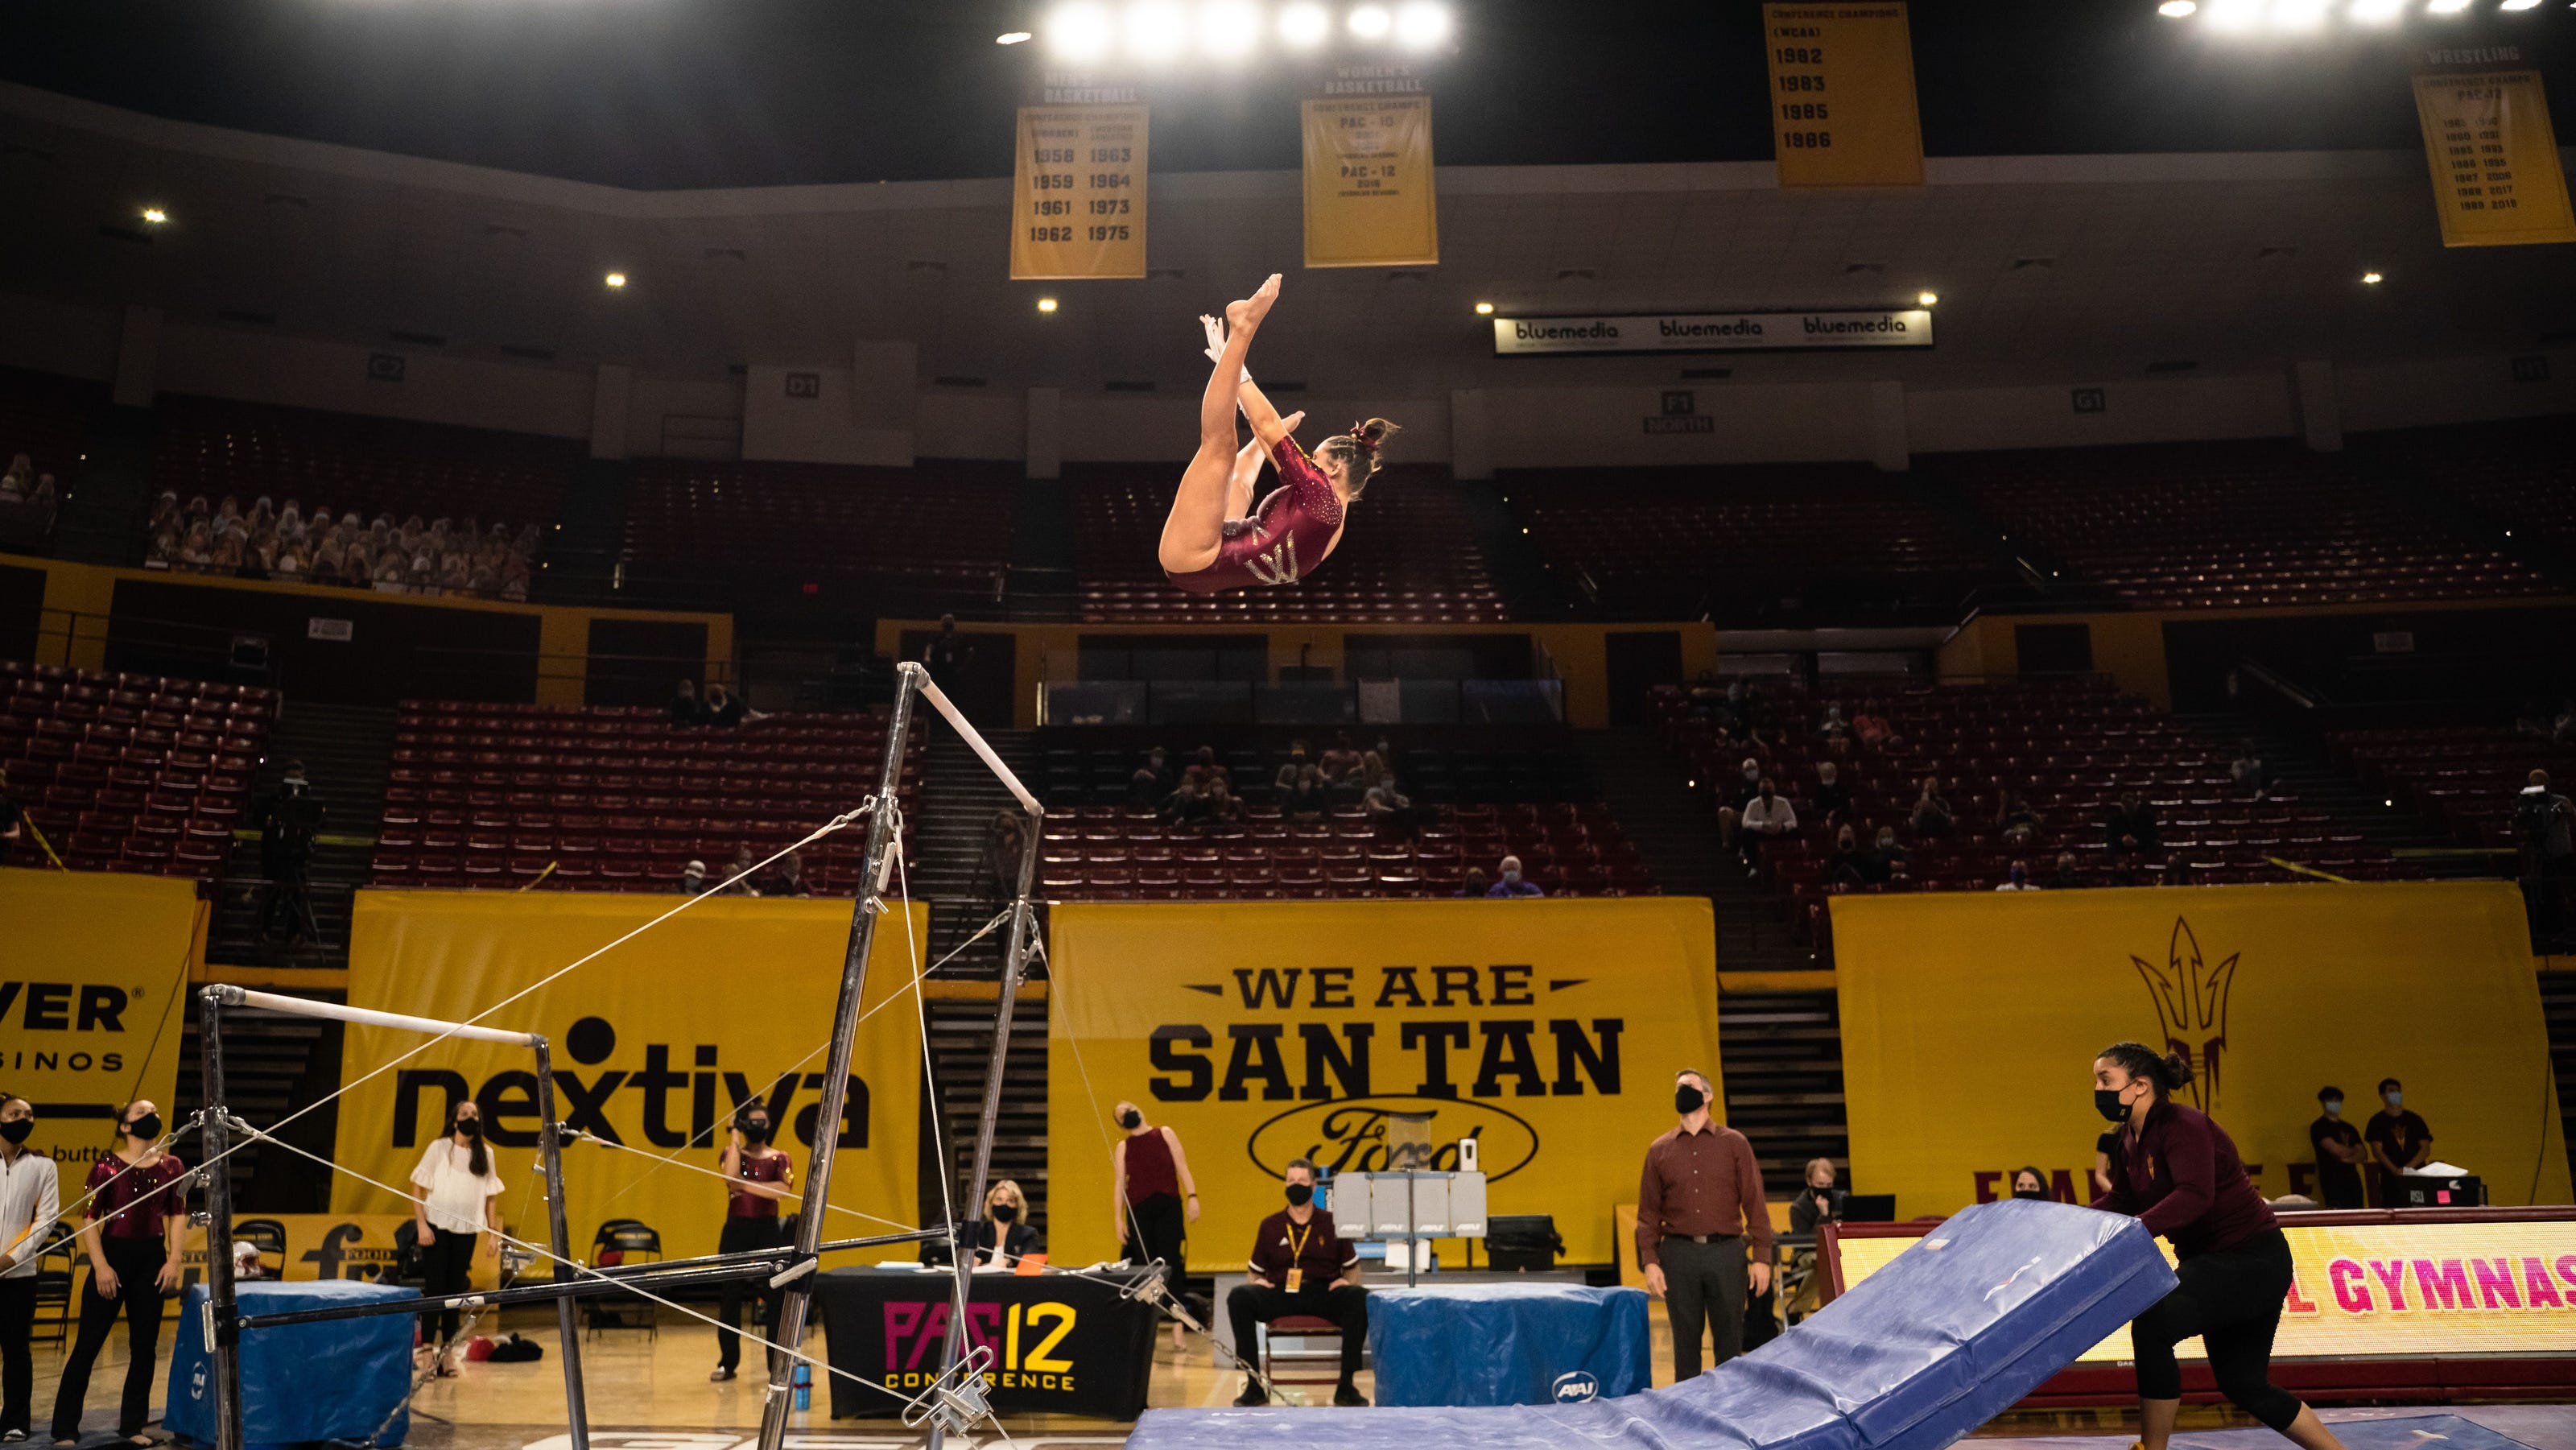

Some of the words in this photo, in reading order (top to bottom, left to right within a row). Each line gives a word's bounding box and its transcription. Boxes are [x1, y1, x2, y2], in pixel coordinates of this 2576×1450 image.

[1772, 10, 1835, 19] CONFERENCE
[1839, 9, 1898, 18] CHAMPIONS
[1777, 48, 1823, 64] 1982
[2427, 46, 2520, 64] WRESTLING
[1325, 80, 1423, 94] BASKETBALL
[1779, 76, 1825, 92] 1983
[1044, 88, 1137, 103] BASKETBALL
[1781, 104, 1828, 120] 1985
[1784, 132, 1831, 148] 1986
[1034, 148, 1074, 163] 1958
[1091, 147, 1131, 163] 1963
[1034, 175, 1073, 189] 1959
[1090, 174, 1130, 188] 1964
[2489, 185, 2512, 195] 2017
[1034, 200, 1071, 215] 1961
[1089, 200, 1129, 214] 1973
[1030, 226, 1072, 242] 1962
[1088, 225, 1129, 241] 1975
[1516, 322, 1619, 340] bluemedia
[1660, 319, 1763, 337] bluemedia
[1802, 316, 1907, 334] bluemedia
[1649, 419, 1710, 433] NORTH
[1234, 968, 1355, 1010] WE
[1375, 965, 1534, 1007] ARE
[1149, 1022, 1375, 1102] SAN
[1401, 1018, 1624, 1098] TAN
[392, 1017, 869, 1148] nextiva
[346, 1250, 391, 1260] FOOD
